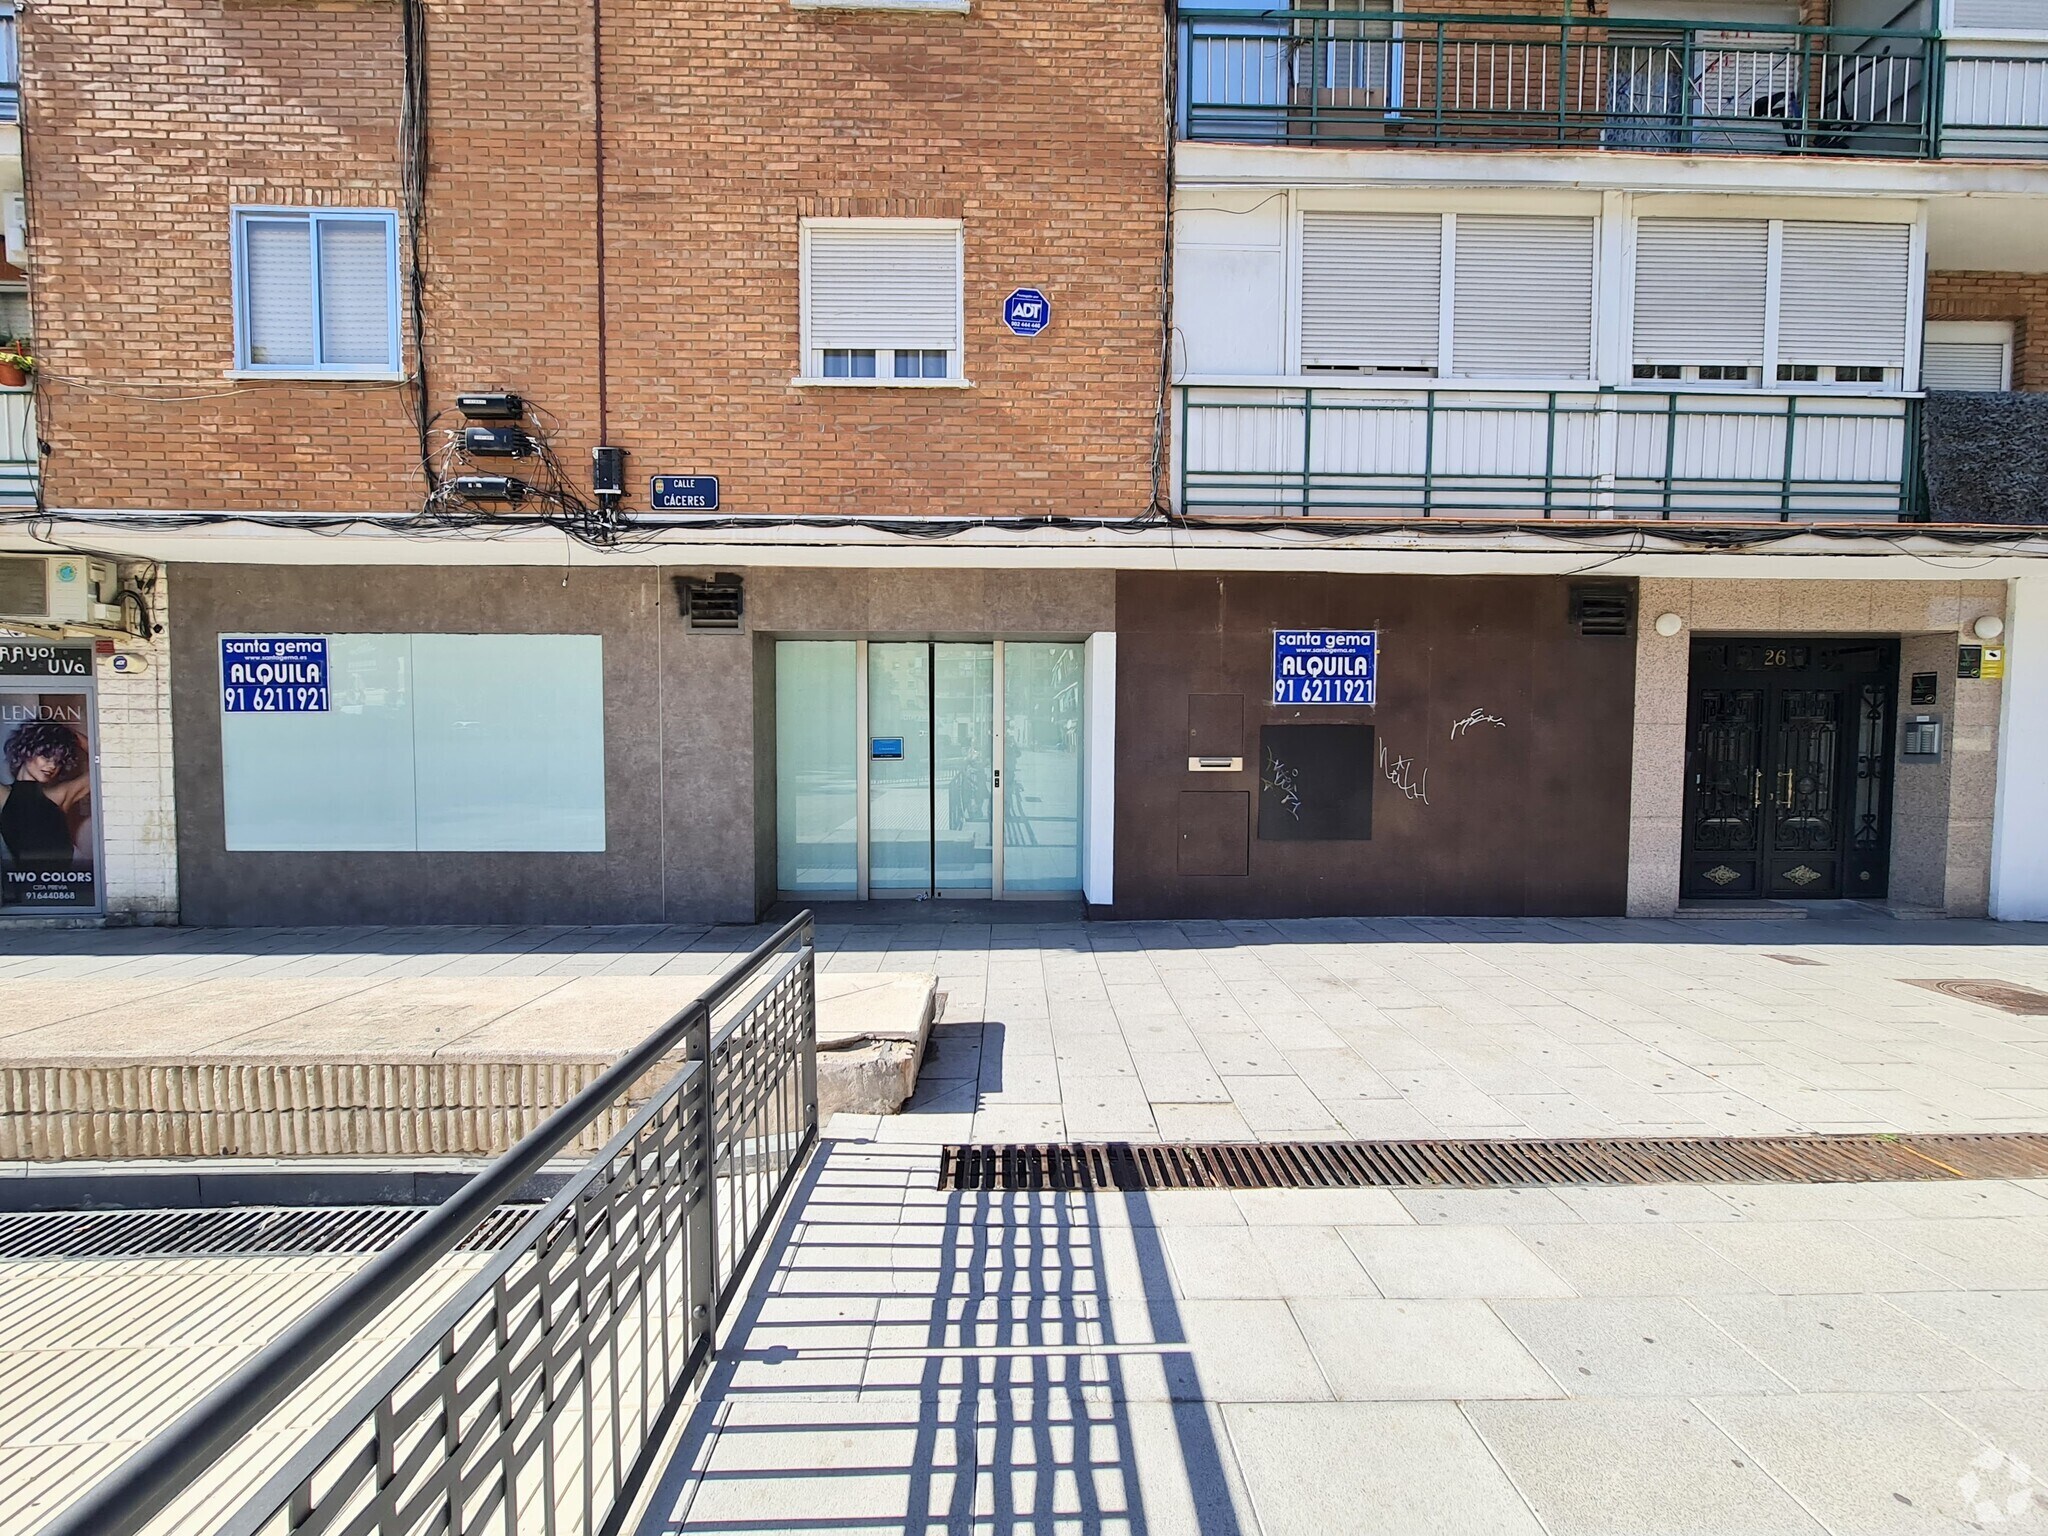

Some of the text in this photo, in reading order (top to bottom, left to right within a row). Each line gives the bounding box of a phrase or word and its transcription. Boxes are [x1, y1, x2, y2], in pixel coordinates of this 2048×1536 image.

[1012, 302, 1041, 319] ADT
[673, 479, 695, 488] CALLE
[663, 493, 706, 506] CÁCERES
[226, 639, 322, 656] santa gema
[1279, 632, 1371, 649] santa gema
[1764, 649, 1786, 666] 26
[231, 663, 320, 686] ALQUILA
[1282, 656, 1368, 678] ALQUILA
[225, 687, 327, 711] 91 6211921
[1275, 679, 1373, 702] 91 6211921
[2, 705, 81, 720] LENDAN
[7, 872, 92, 882] TWO COLORS
[26, 892, 76, 900] 916440868
